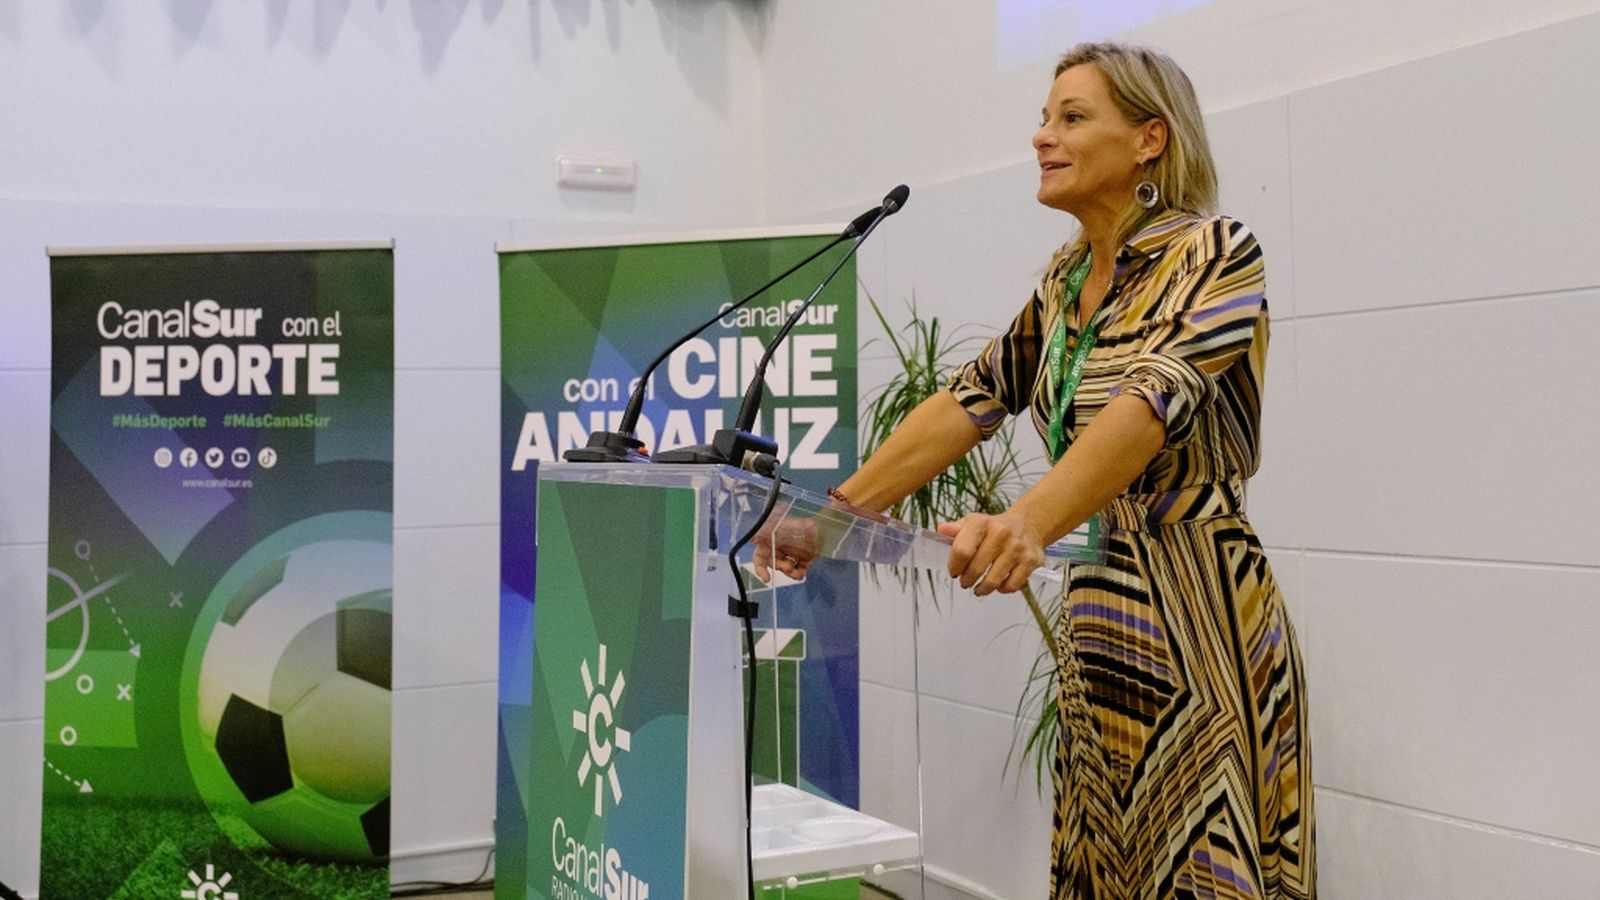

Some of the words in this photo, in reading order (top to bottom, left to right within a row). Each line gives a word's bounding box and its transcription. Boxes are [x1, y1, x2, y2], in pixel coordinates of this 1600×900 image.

[97, 300, 262, 339] CanalSur
[282, 316, 318, 337] con
[323, 311, 342, 336] el
[719, 299, 838, 328] CanalSur
[100, 343, 340, 396] DEPORTE
[563, 378, 619, 403] con
[668, 334, 838, 399] CINE
[112, 413, 207, 430] #MásDeporte
[224, 413, 331, 428] #MásCanalSur
[183, 478, 252, 488] www.canalsur.es
[552, 817, 648, 900] CanalSur
